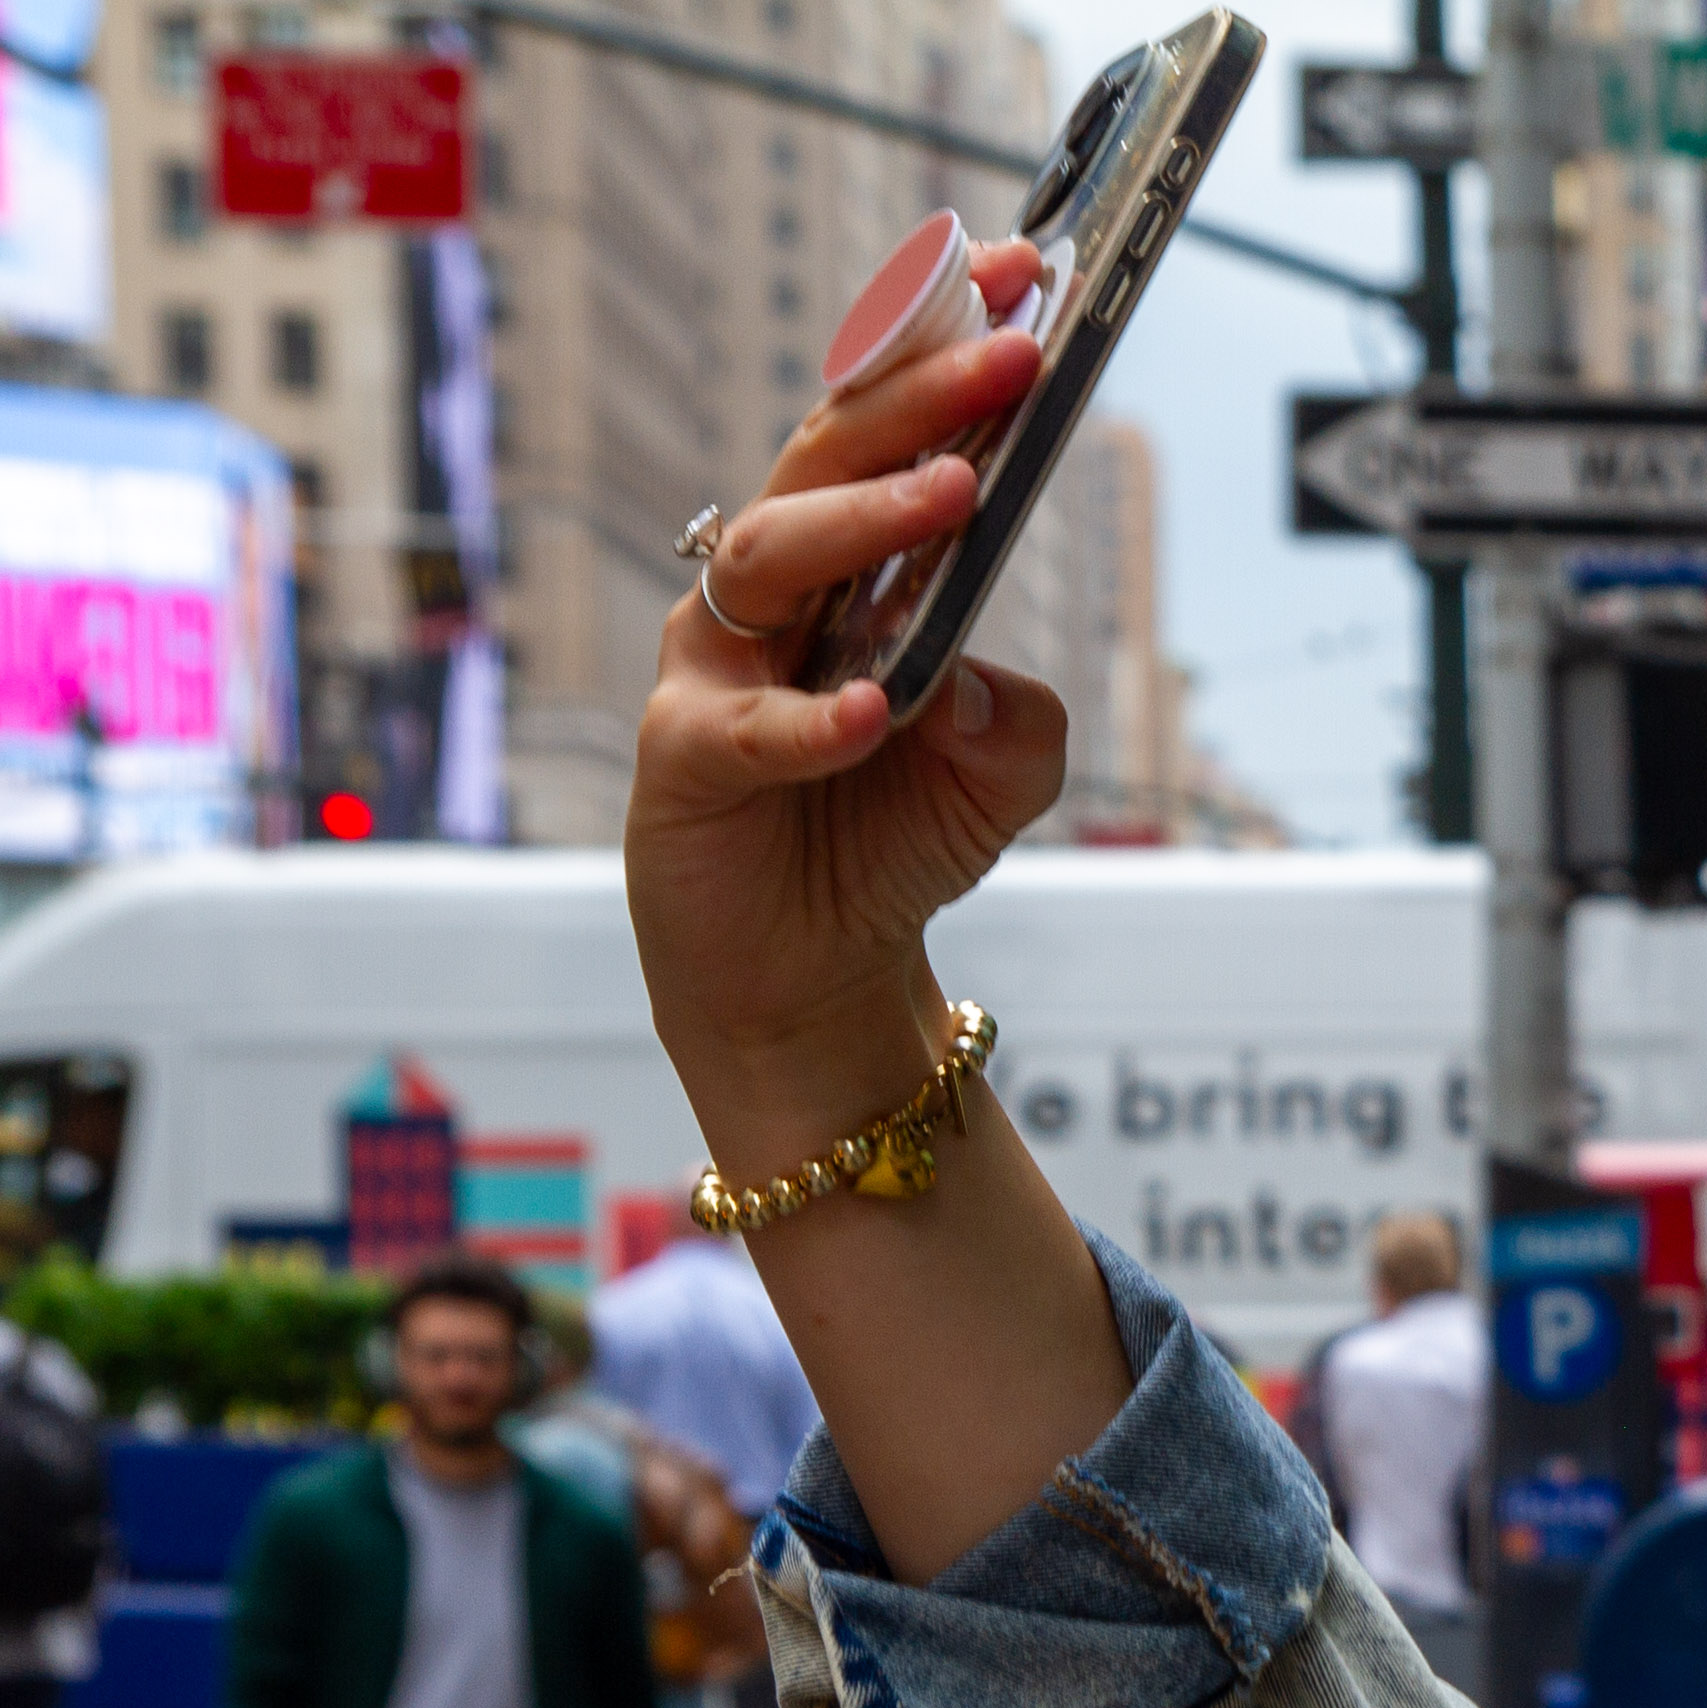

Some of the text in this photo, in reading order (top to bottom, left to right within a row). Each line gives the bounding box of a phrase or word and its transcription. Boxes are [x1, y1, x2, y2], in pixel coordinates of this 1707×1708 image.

[1344, 440, 1478, 496] ONE
[1114, 1046, 1404, 1152] bring
[1526, 1284, 1598, 1385] P
